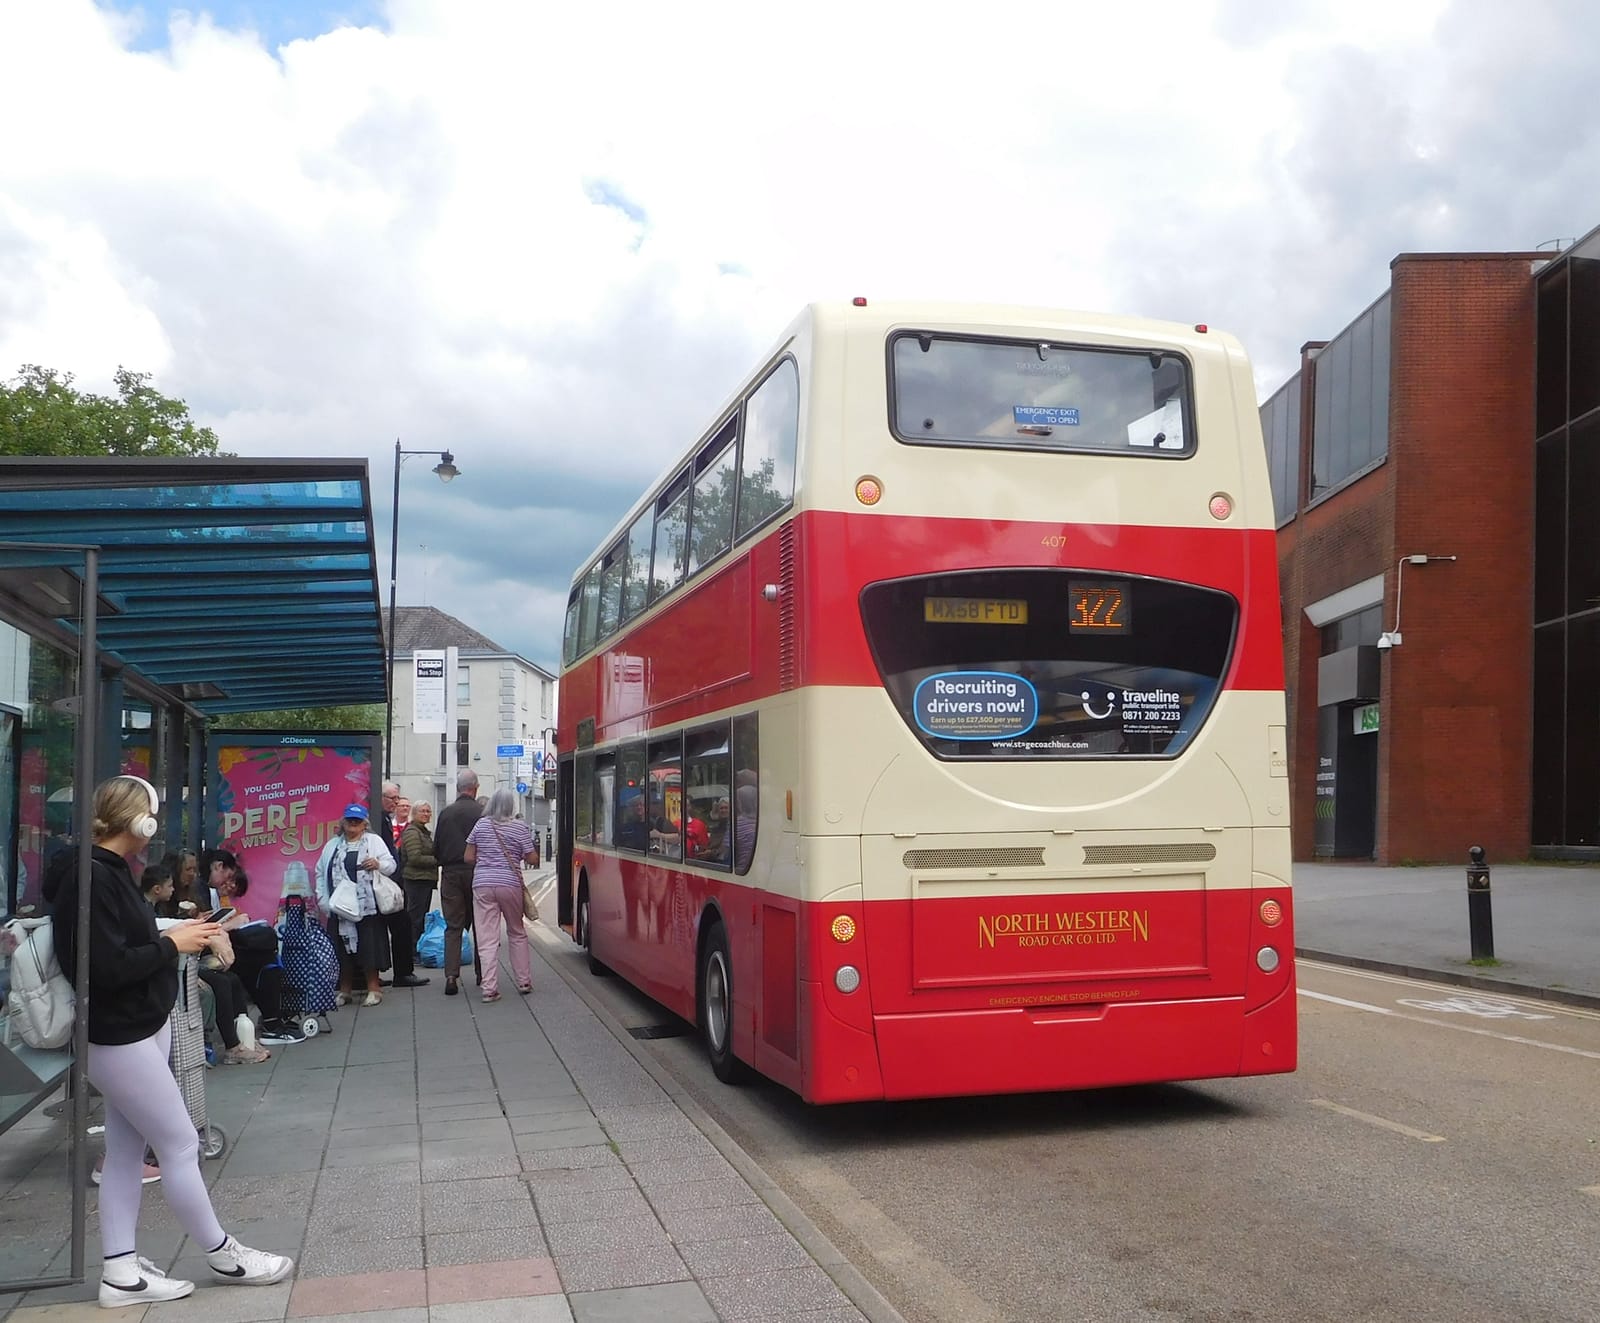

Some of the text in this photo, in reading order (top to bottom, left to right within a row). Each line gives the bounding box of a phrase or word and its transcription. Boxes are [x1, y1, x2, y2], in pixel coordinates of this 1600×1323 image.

[1015, 406, 1077, 416] EMERGENCY EXIT
[1058, 416, 1078, 424] OPEN
[1040, 536, 1067, 547] 407
[932, 601, 1020, 620] MX58 FTD
[1071, 588, 1123, 627] 322
[429, 669, 442, 677] Stop
[935, 679, 1017, 697] Recruiting
[1122, 689, 1180, 703] traveline
[927, 698, 1025, 713] drivers now!
[966, 716, 994, 724] £27,500
[1007, 717, 1022, 725] year
[1122, 711, 1181, 720] 0871 200 2233
[992, 740, 1089, 750] www.stagecoachbus.com
[244, 781, 283, 795] you can
[258, 782, 330, 801] make anything
[223, 800, 309, 839] PERF
[240, 832, 278, 849] WITH
[978, 910, 1149, 949] NORTH WESTERN
[1018, 932, 1117, 947] ROAD CAR CO. LTD.
[989, 989, 1141, 1006] EMERGENCY ENGINE STOP BEHIND FLAP
